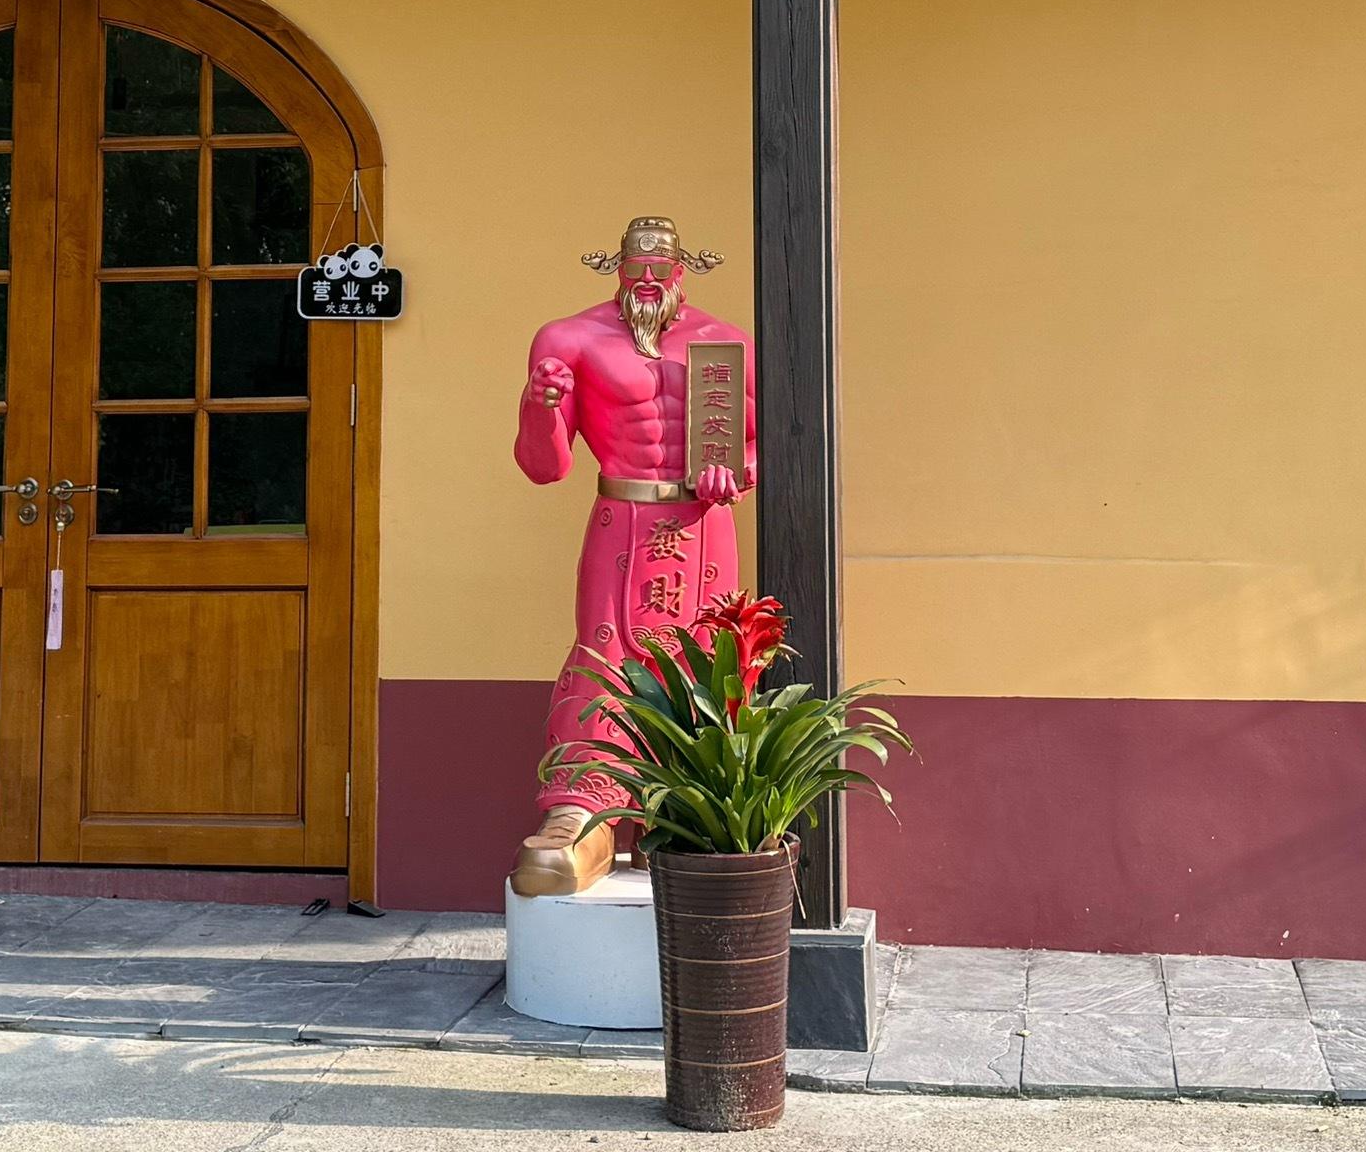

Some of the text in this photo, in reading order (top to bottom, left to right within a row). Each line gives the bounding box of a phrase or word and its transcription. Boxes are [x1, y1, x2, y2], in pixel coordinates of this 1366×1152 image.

[312, 280, 390, 302] 营业中
[325, 302, 377, 314] 欢迎光临
[701, 362, 733, 463] 指定发财
[643, 516, 696, 618] 發財
